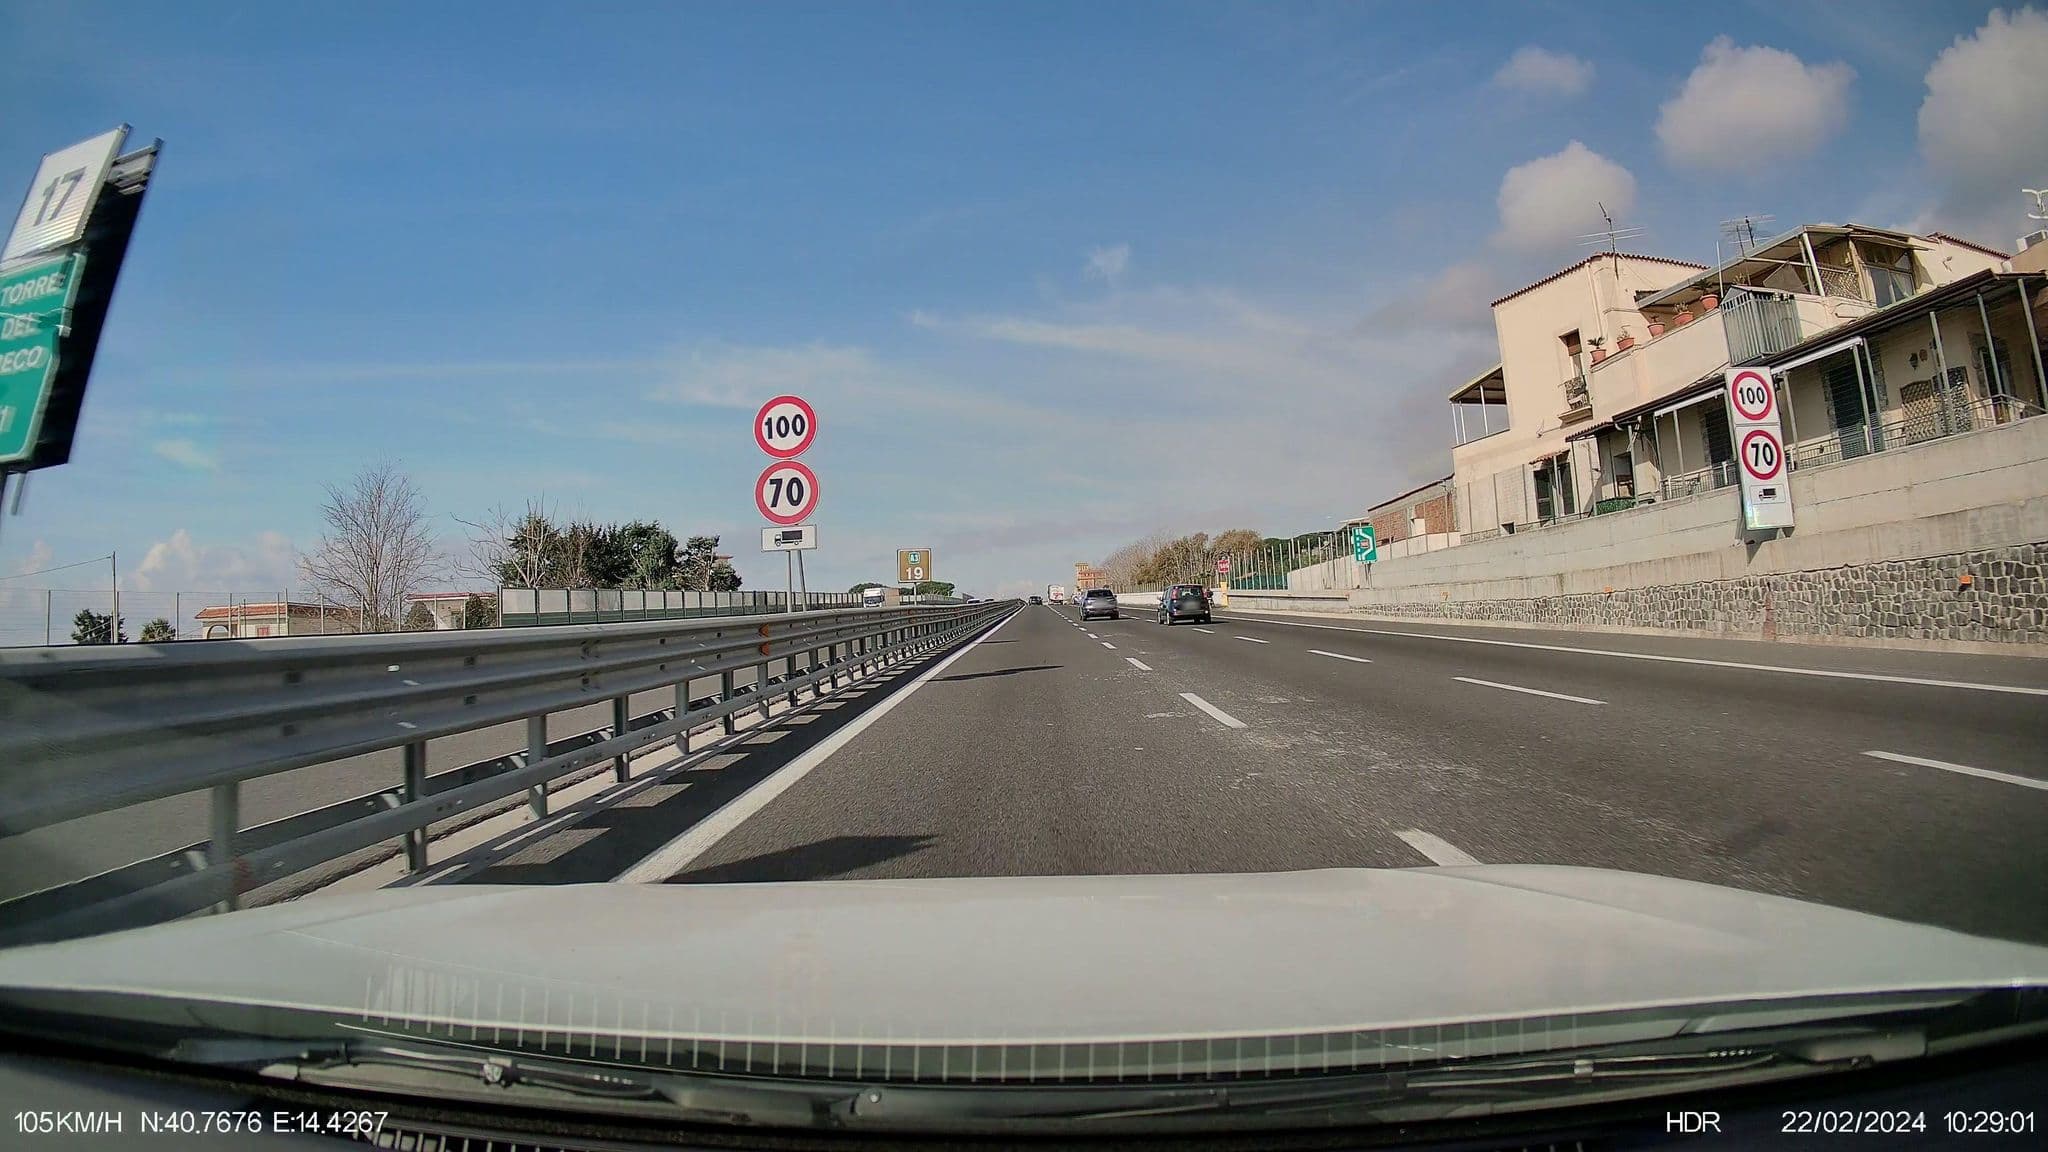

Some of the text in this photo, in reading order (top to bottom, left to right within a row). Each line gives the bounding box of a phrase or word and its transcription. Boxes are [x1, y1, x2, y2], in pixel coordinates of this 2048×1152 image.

[33, 167, 86, 227] 17
[1, 272, 64, 307] TORRE
[2, 313, 40, 339] DEL
[0, 346, 43, 374] ECO
[1738, 386, 1766, 405] 100
[764, 413, 806, 440] 100
[1751, 442, 1774, 467] 70
[769, 477, 804, 508] 70
[905, 567, 924, 580] 19
